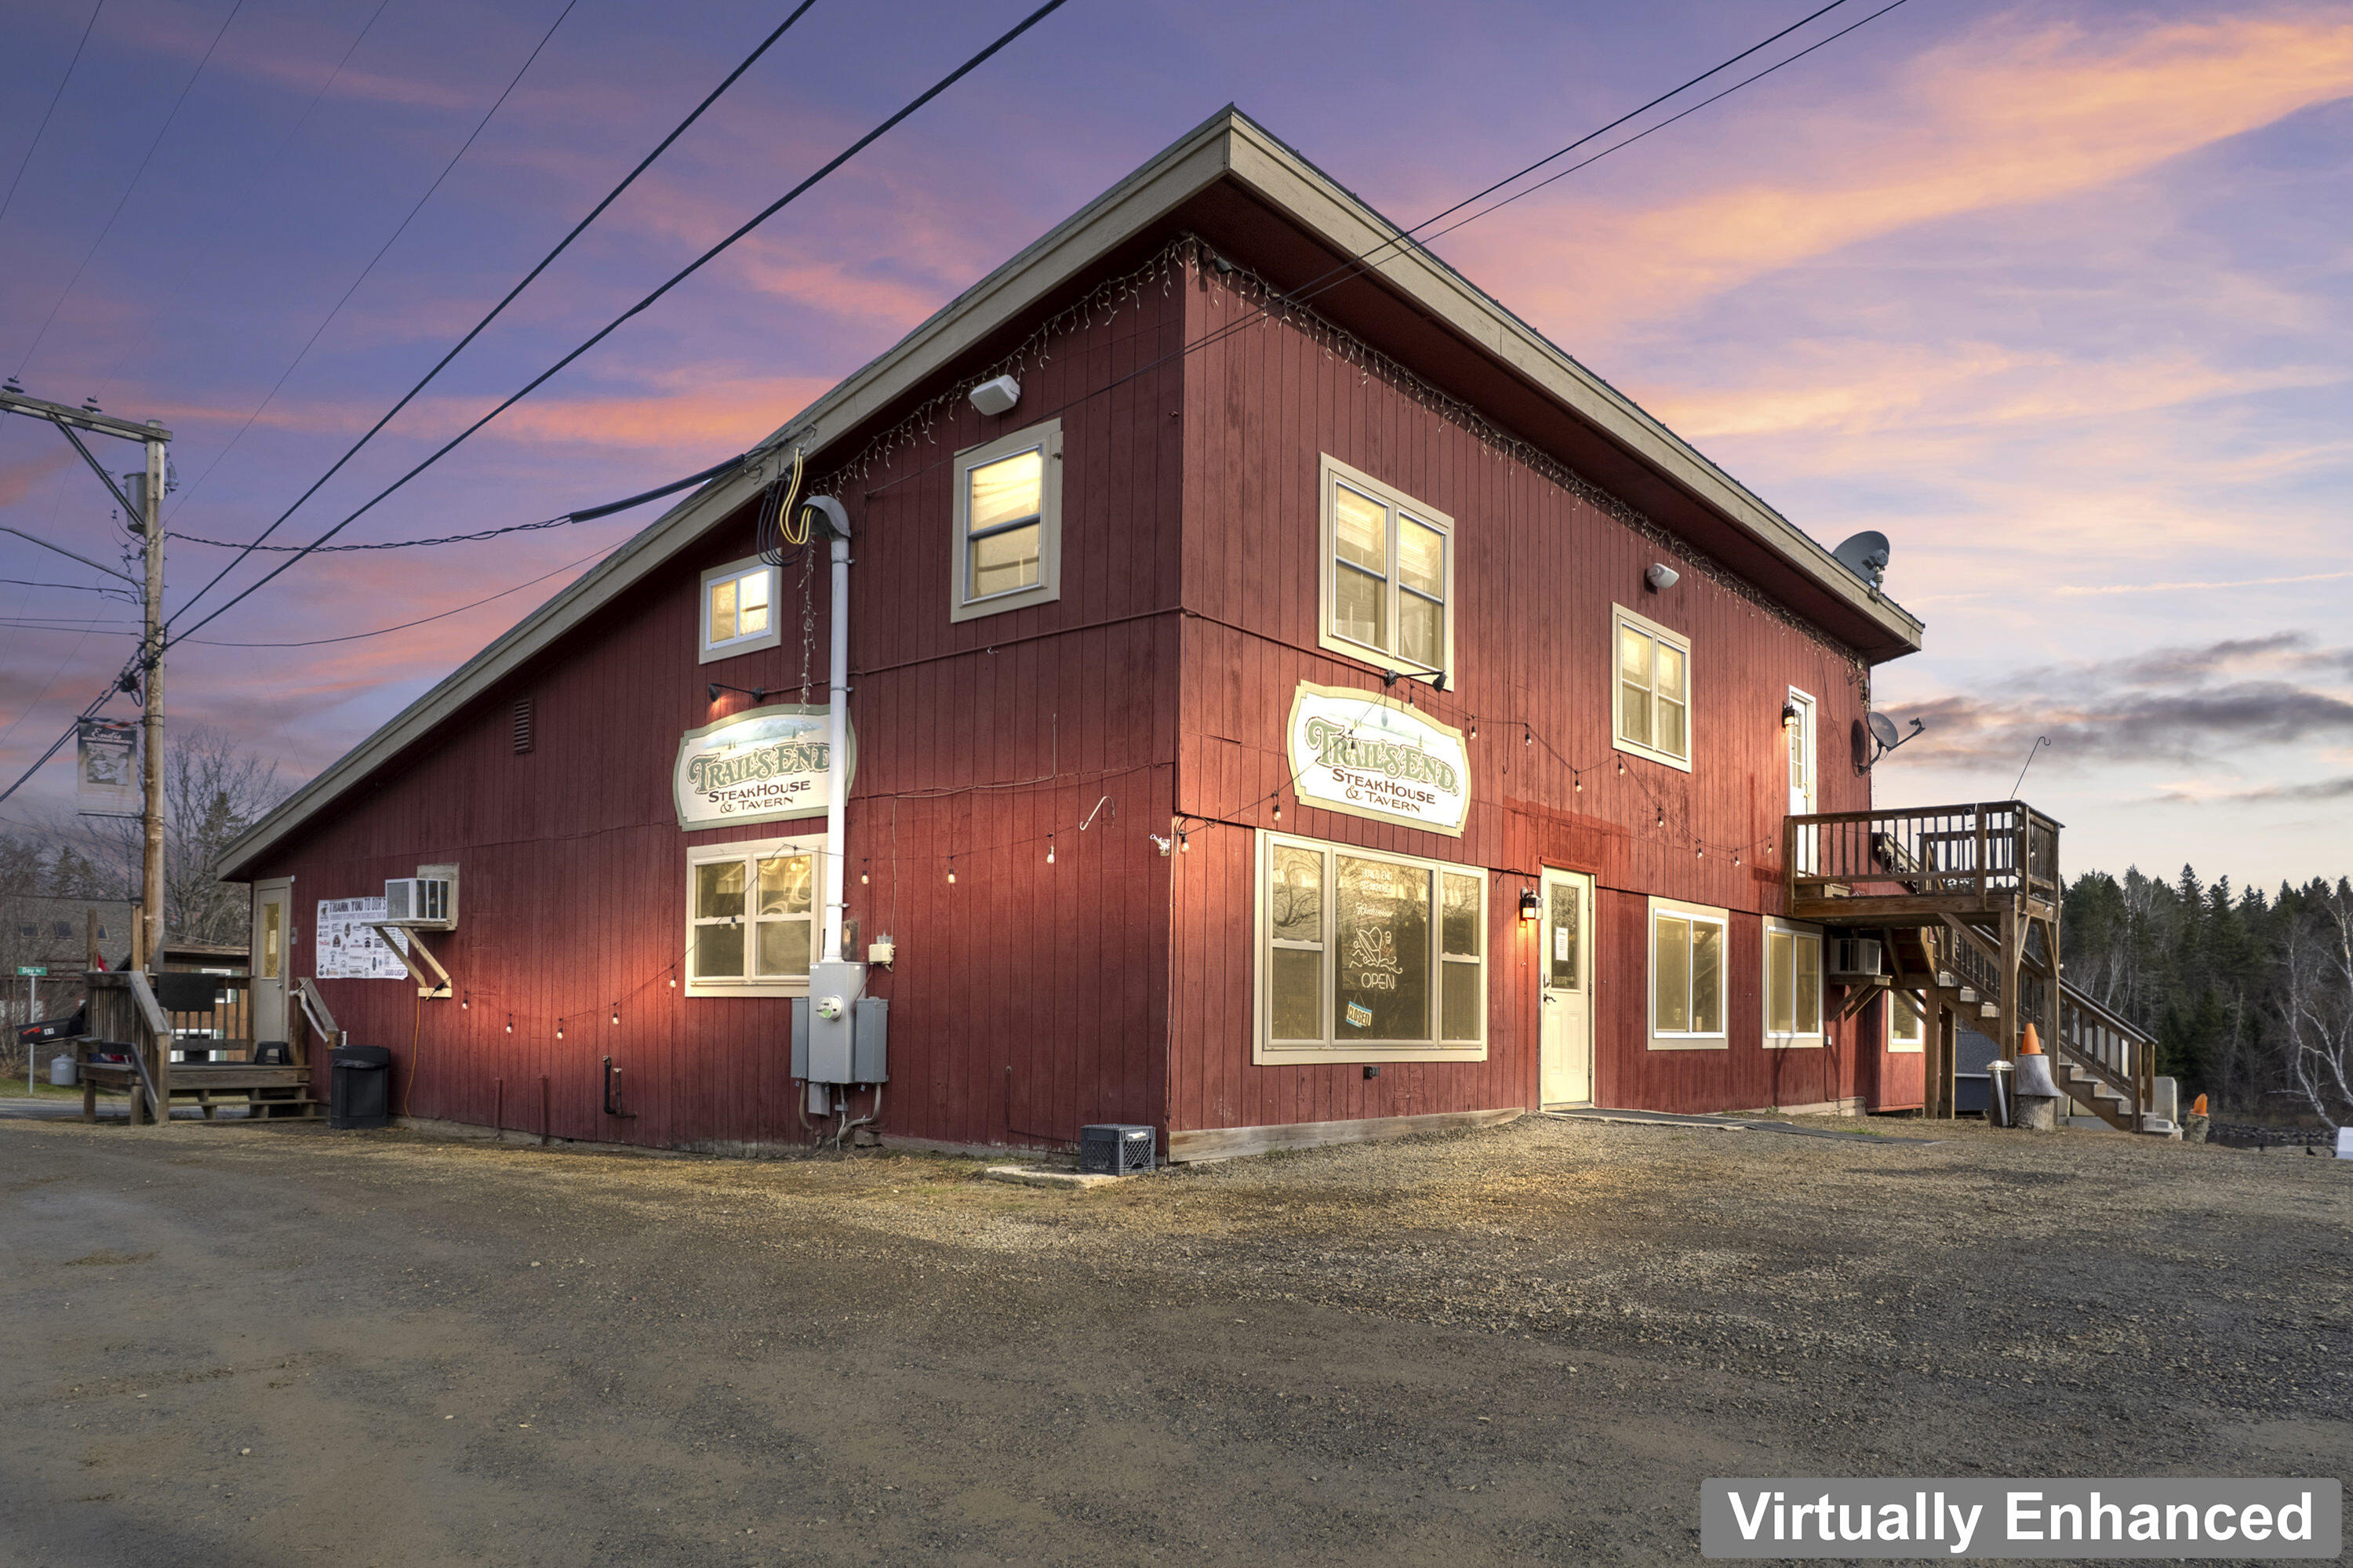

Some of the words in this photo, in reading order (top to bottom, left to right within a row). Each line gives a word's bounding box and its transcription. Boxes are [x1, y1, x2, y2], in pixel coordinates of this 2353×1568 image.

[1400, 744, 1459, 796] END
[708, 780, 811, 803] STEAKHOUSE
[1333, 769, 1436, 804] STEAKHOUSE
[720, 800, 736, 813] &
[738, 796, 794, 810] TAVERN
[1346, 785, 1363, 800] &
[1366, 791, 1420, 813] TAVERN
[329, 901, 349, 912] THANK
[351, 900, 363, 911] YOU
[1362, 973, 1395, 990] OPEN
[1348, 1006, 1370, 1026] CLOSED
